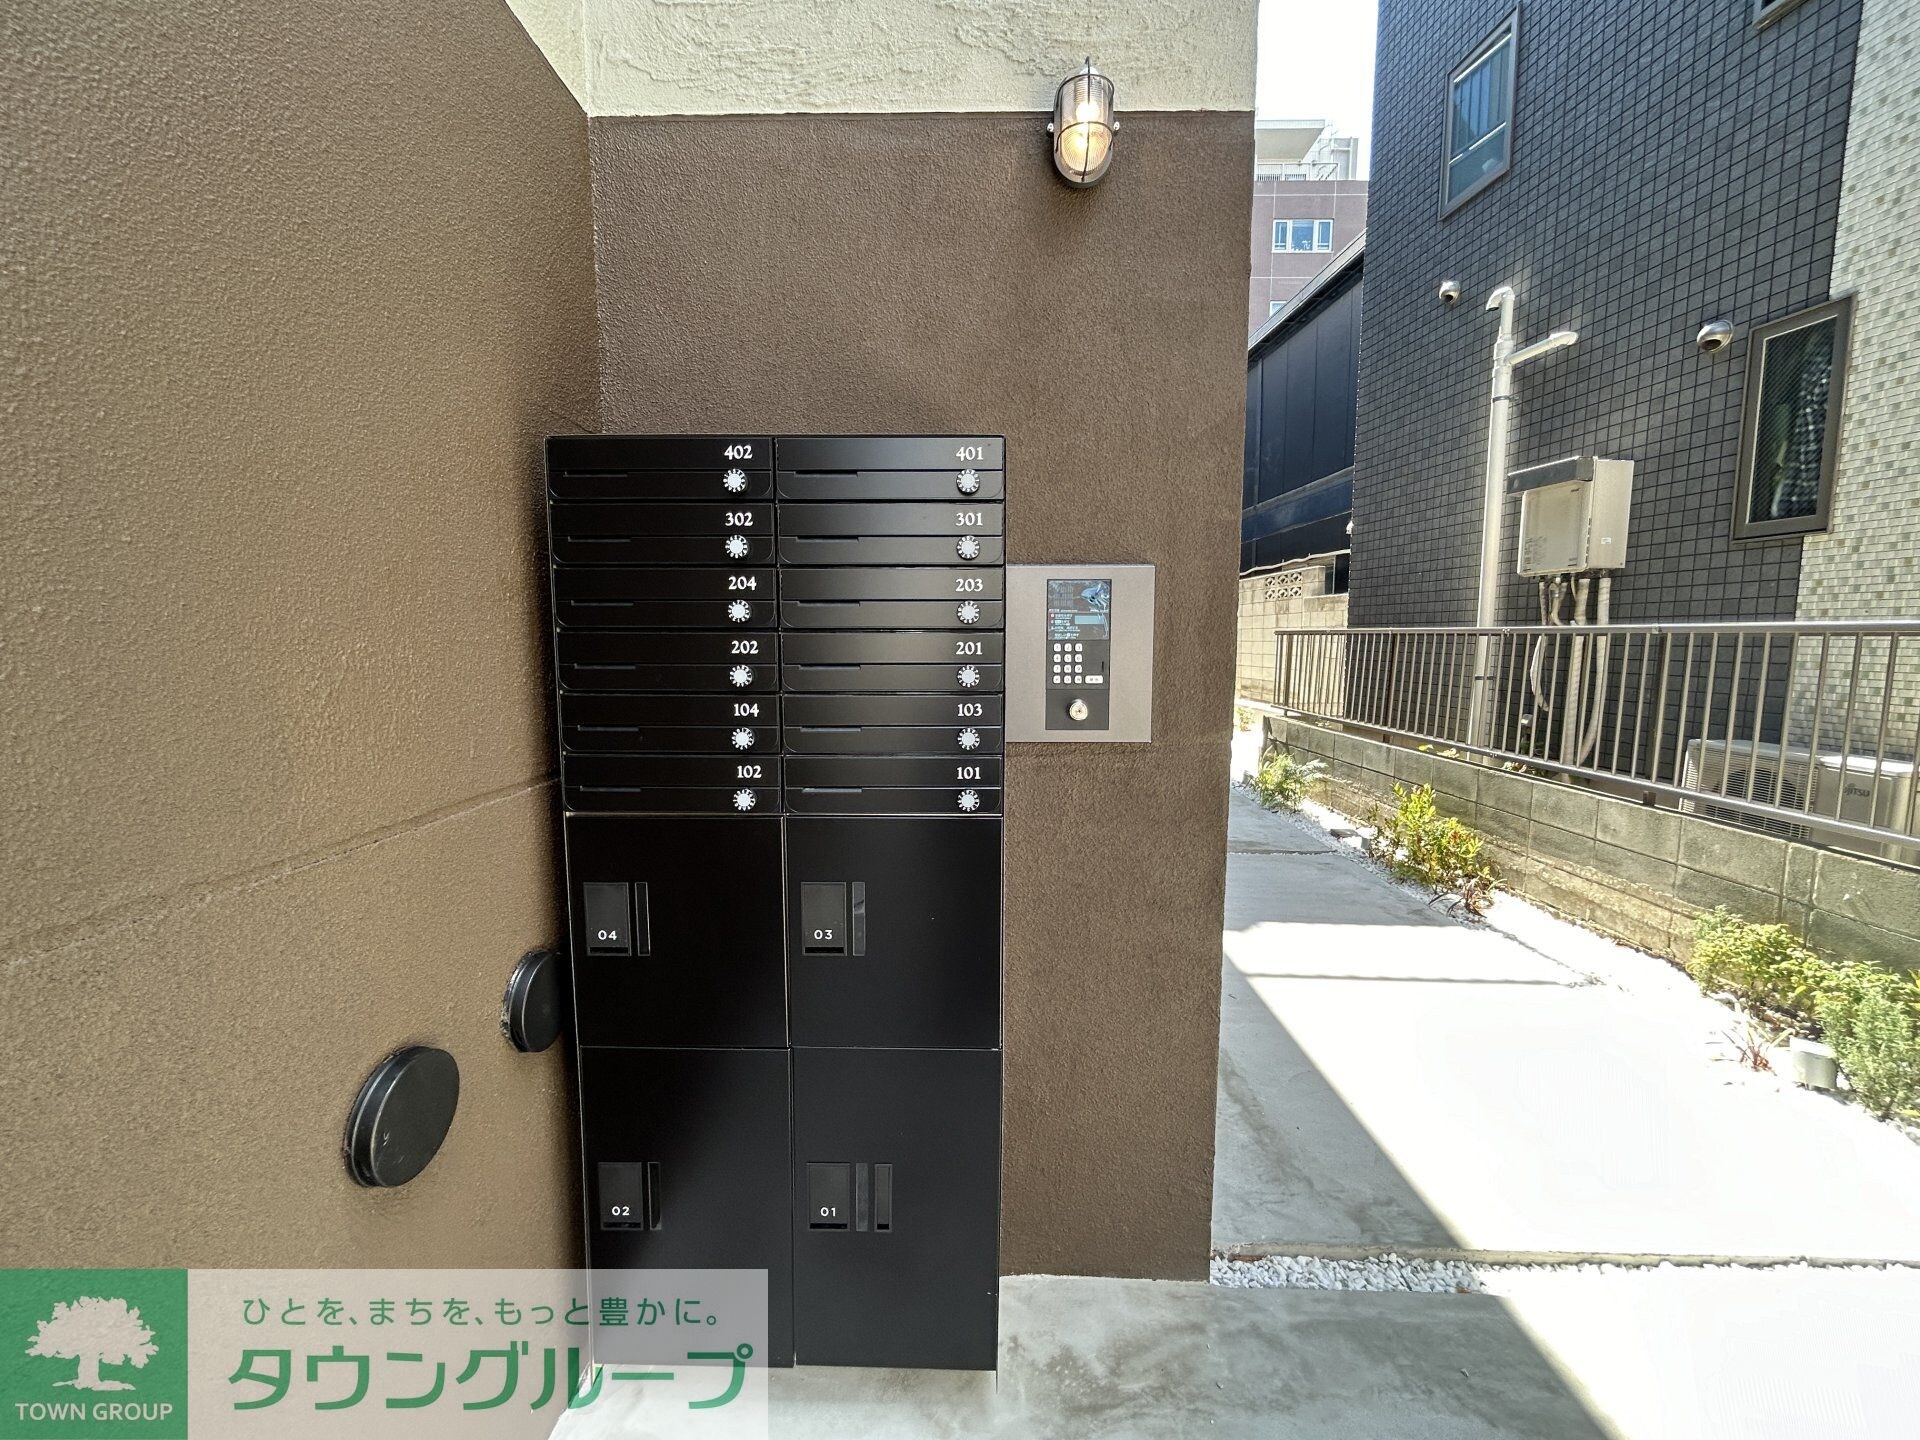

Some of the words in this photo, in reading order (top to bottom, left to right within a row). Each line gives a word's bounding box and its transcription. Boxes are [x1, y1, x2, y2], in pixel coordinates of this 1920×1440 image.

[724, 444, 753, 461] 402
[956, 446, 984, 462] 401
[725, 511, 754, 527] 302
[956, 512, 984, 527] 301
[728, 575, 757, 591] 204
[955, 578, 984, 592] 203
[731, 640, 759, 655] 202
[956, 641, 983, 655] 201
[733, 702, 760, 718] 104
[957, 703, 983, 717] 103
[737, 764, 762, 779] 102
[957, 766, 981, 780] 101
[597, 929, 618, 941] 04
[813, 929, 833, 940] 03
[611, 1205, 630, 1216] 02
[820, 1206, 836, 1217] 01
